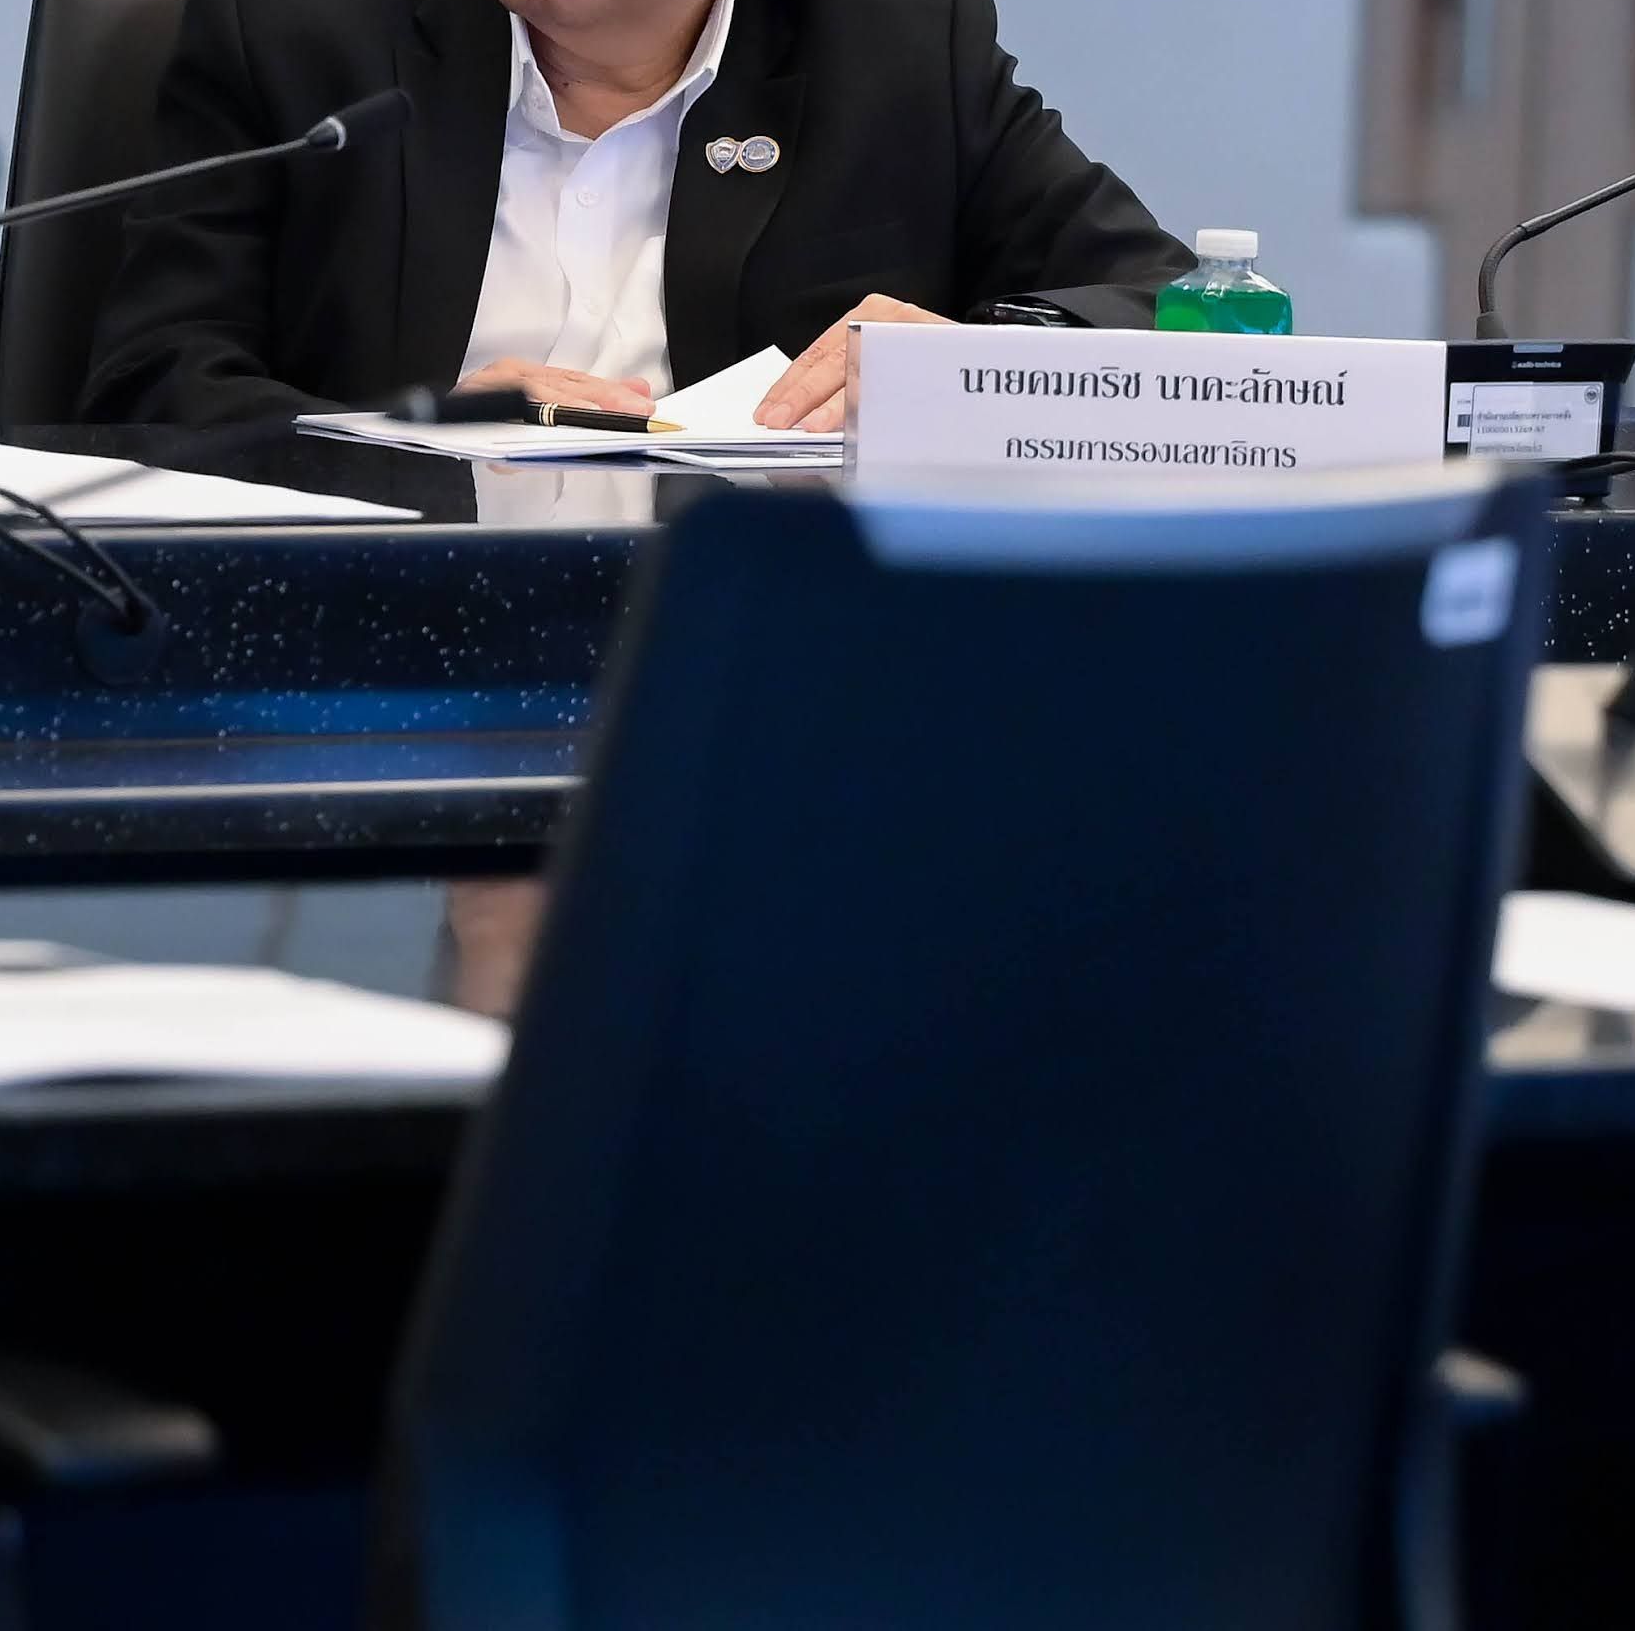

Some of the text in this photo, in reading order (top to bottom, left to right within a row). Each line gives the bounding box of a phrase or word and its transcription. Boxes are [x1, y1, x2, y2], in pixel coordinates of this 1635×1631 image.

[959, 366, 1348, 406] นายคมกริช นาคะลักษณ์
[1005, 436, 1296, 468] กรรมการรองเลขาธิการ
